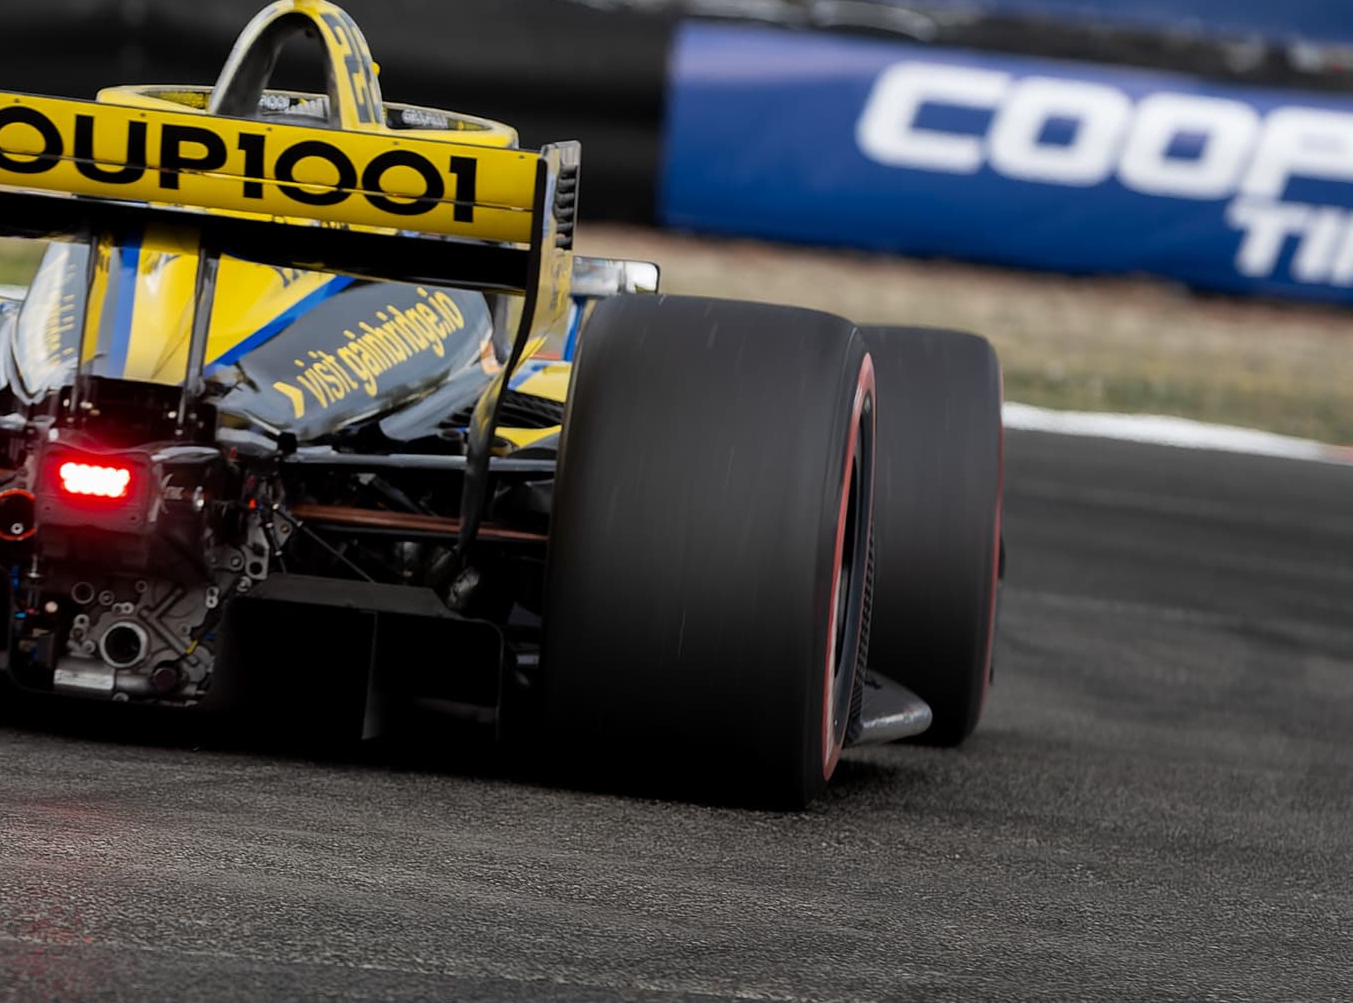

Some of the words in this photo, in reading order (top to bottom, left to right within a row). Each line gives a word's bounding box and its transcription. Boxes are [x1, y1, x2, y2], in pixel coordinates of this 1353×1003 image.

[1226, 201, 1353, 288] TI
[294, 350, 359, 408] visit
[337, 287, 465, 398] gainbridge.io
